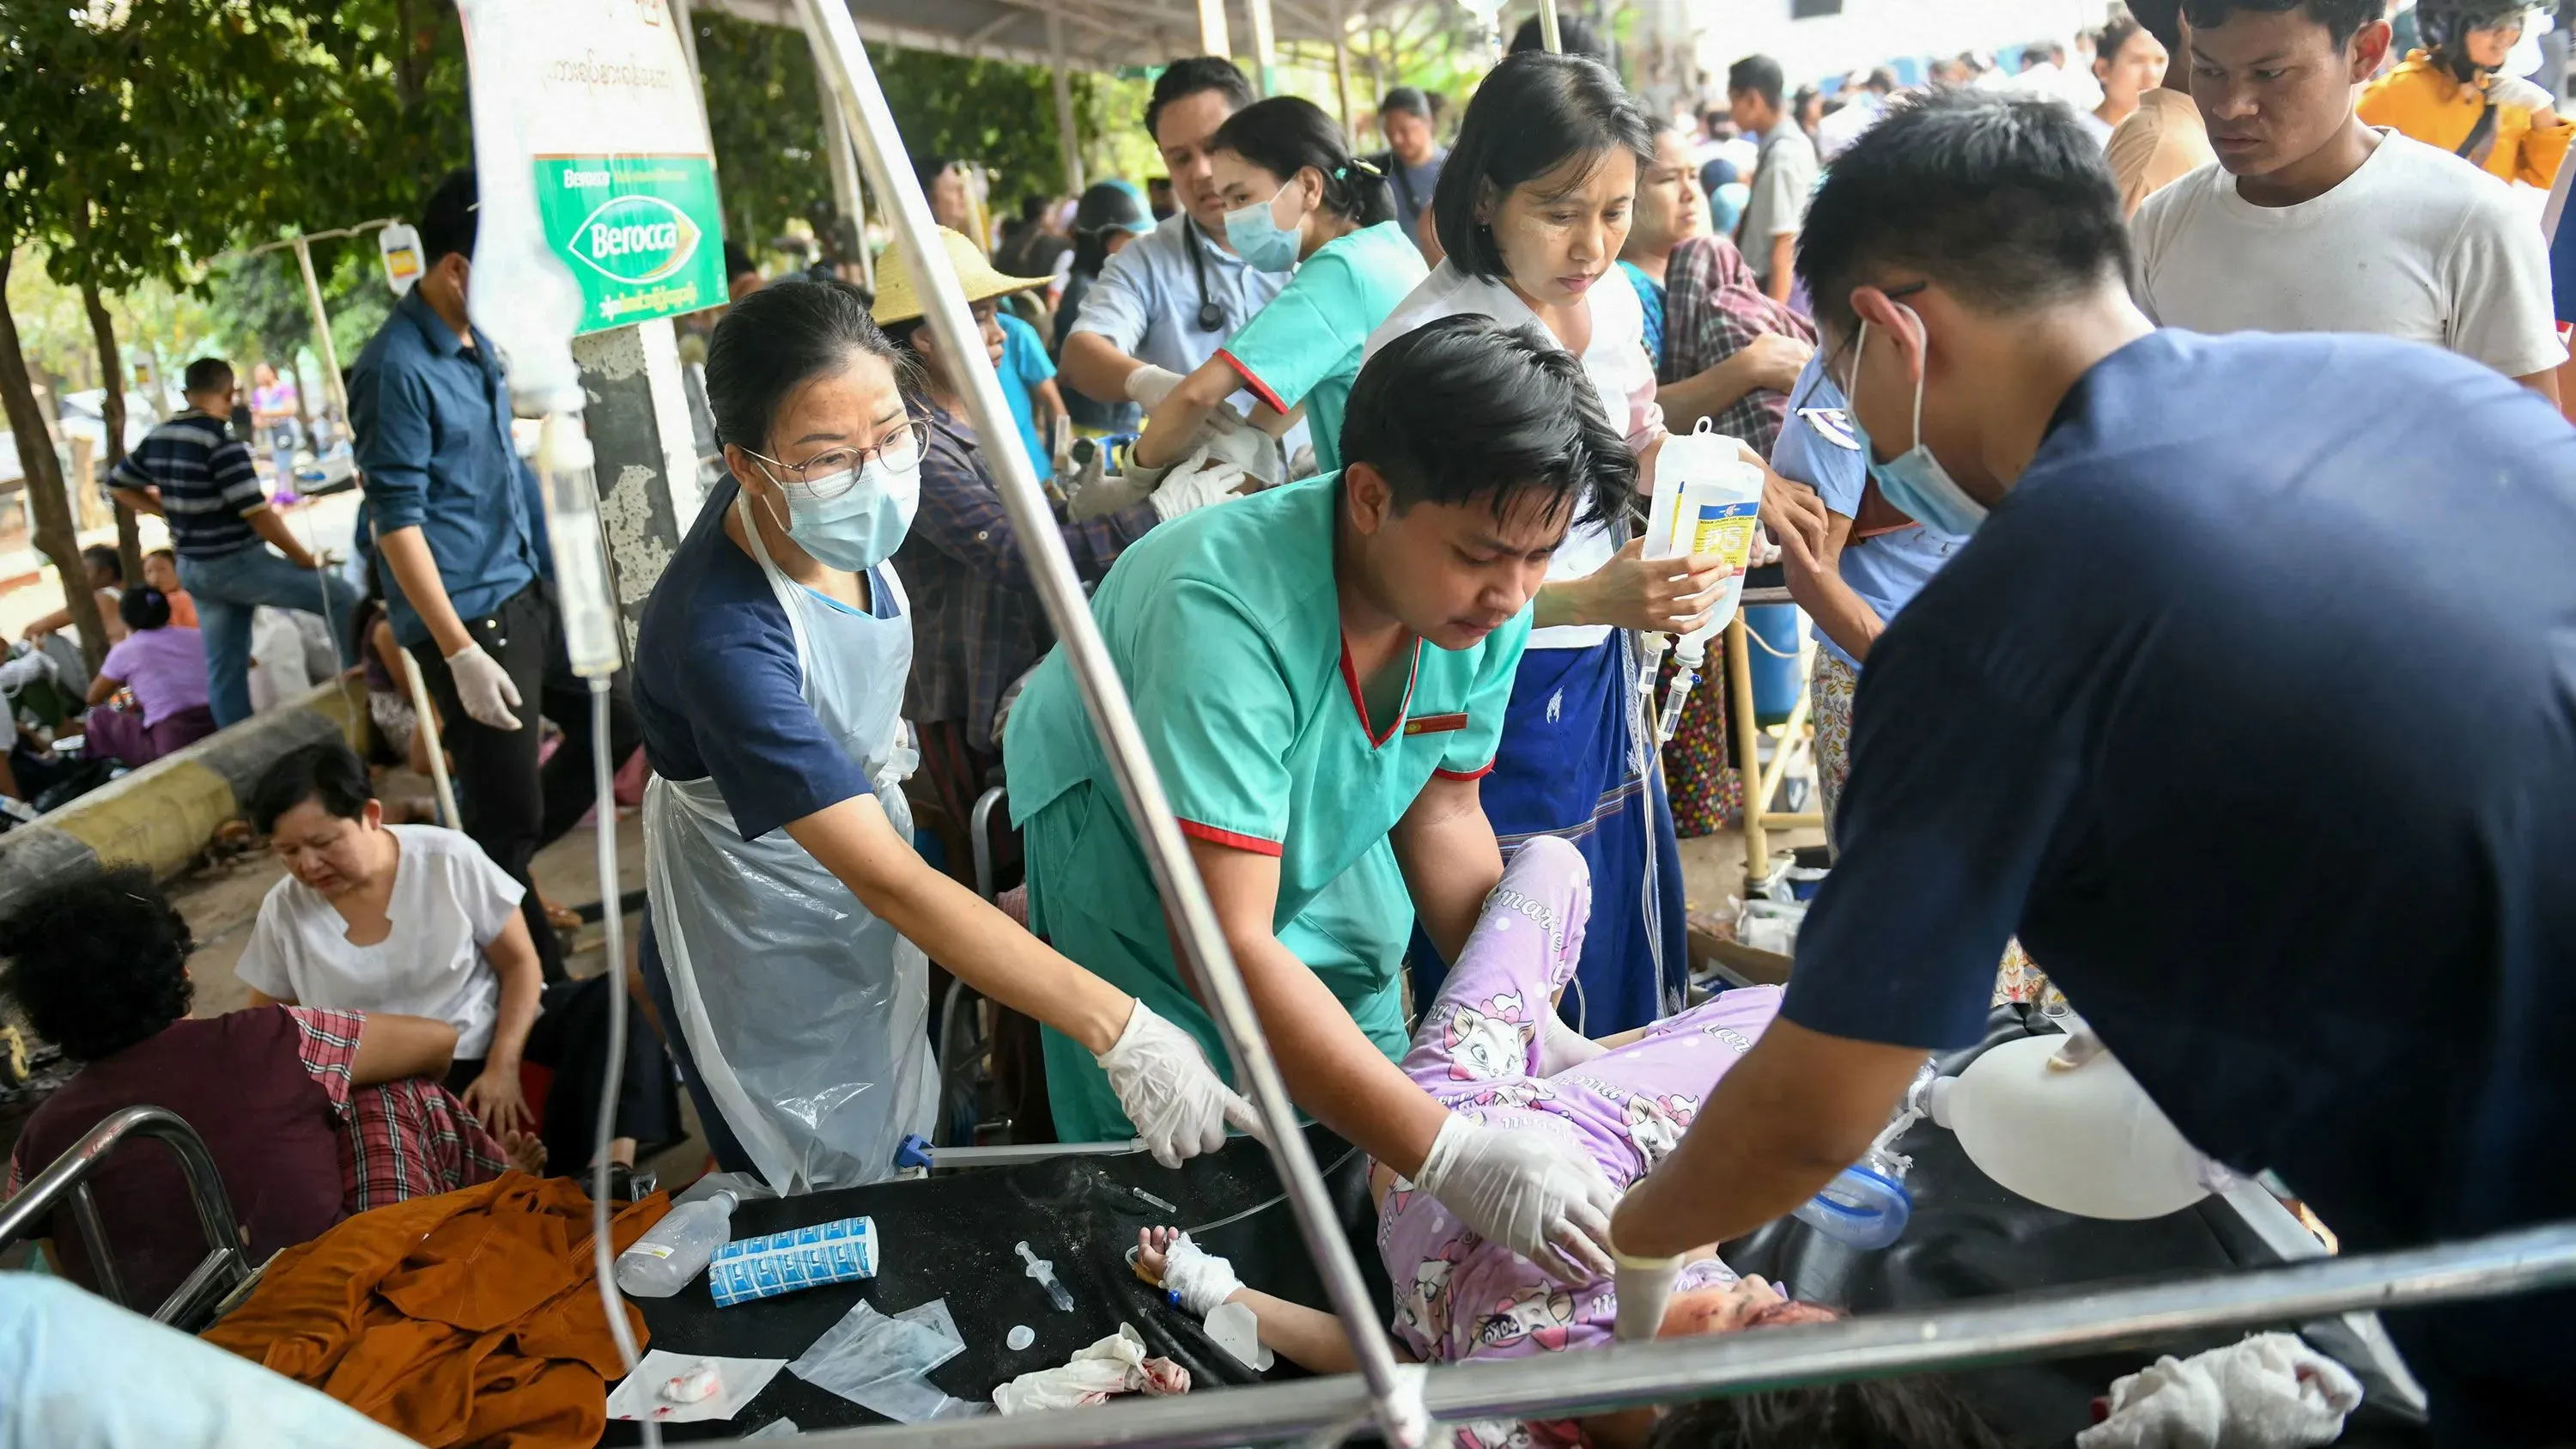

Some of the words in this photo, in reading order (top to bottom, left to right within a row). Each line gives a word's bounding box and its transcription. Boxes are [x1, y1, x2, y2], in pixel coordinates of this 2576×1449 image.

[563, 169, 611, 188] Berocca
[590, 222, 677, 259] Berocca
[1497, 889, 1564, 953] marie
